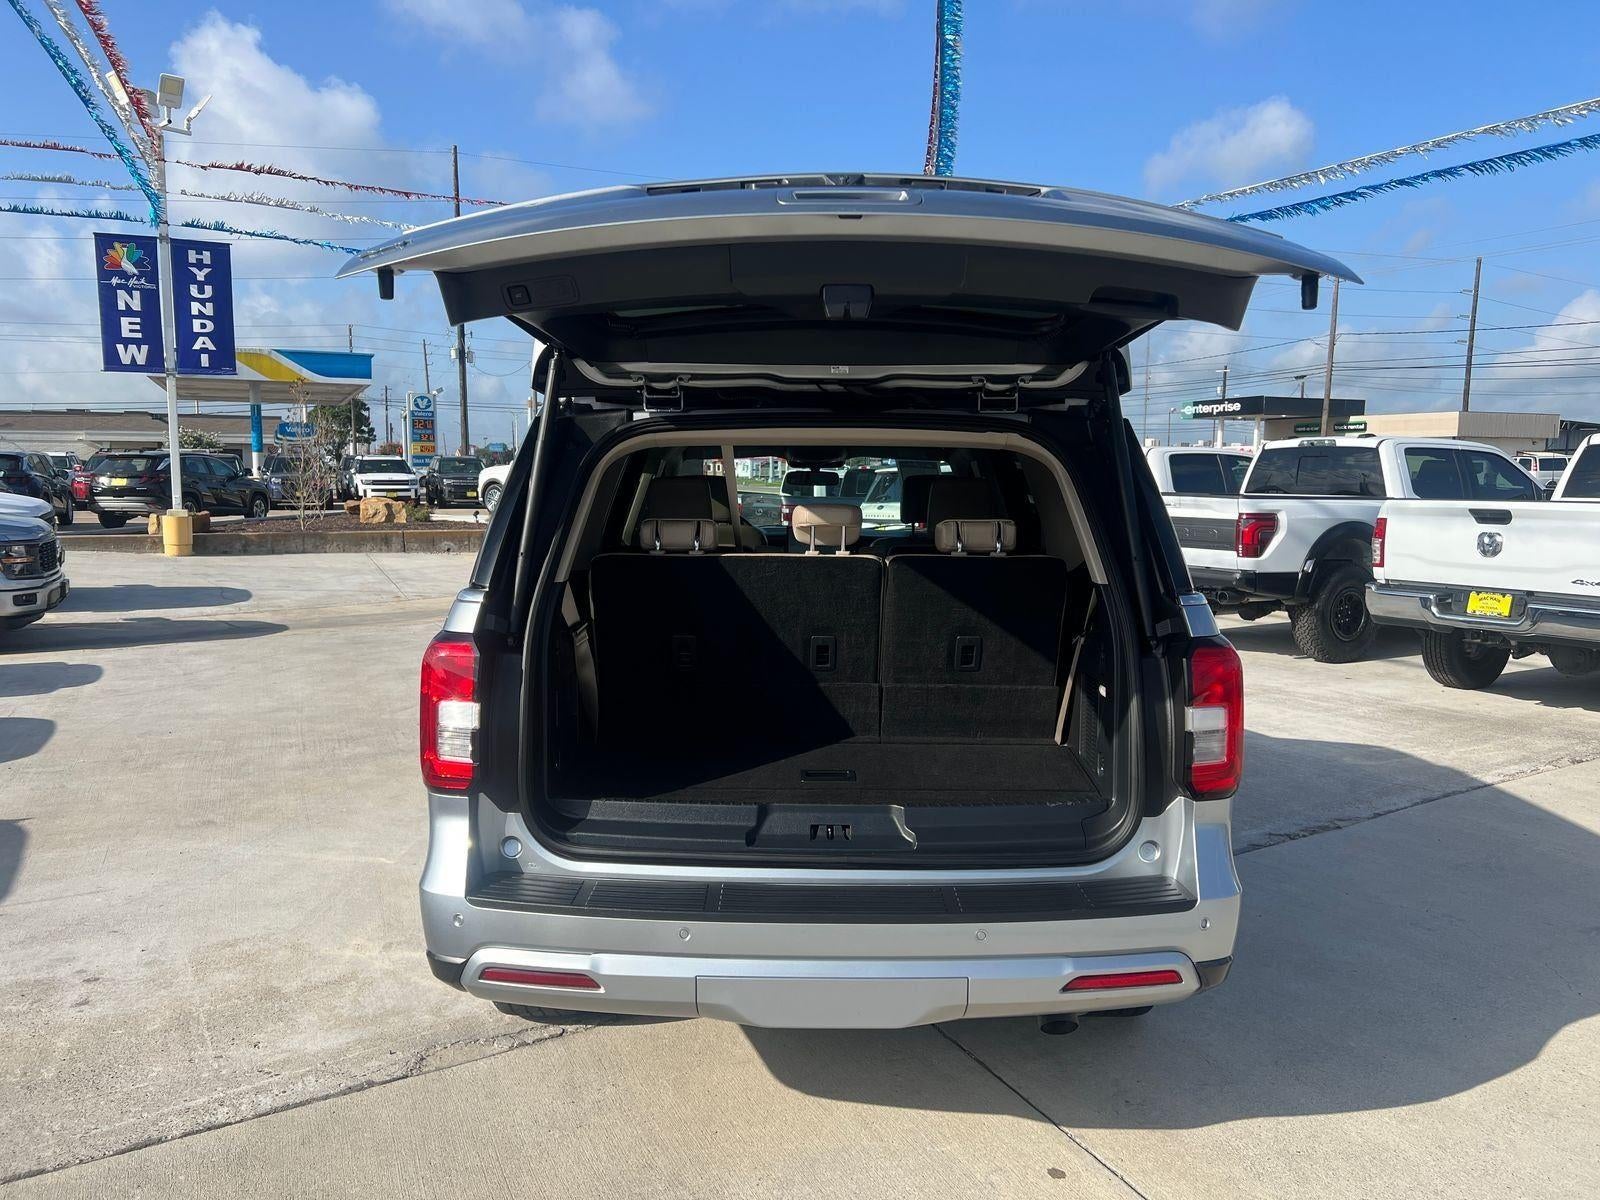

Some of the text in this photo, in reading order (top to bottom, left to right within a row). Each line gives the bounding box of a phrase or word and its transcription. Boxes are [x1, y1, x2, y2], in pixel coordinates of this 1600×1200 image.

[115, 289, 149, 365] NEW
[187, 249, 217, 367] HYUNDAI
[1184, 400, 1242, 415] enterprise
